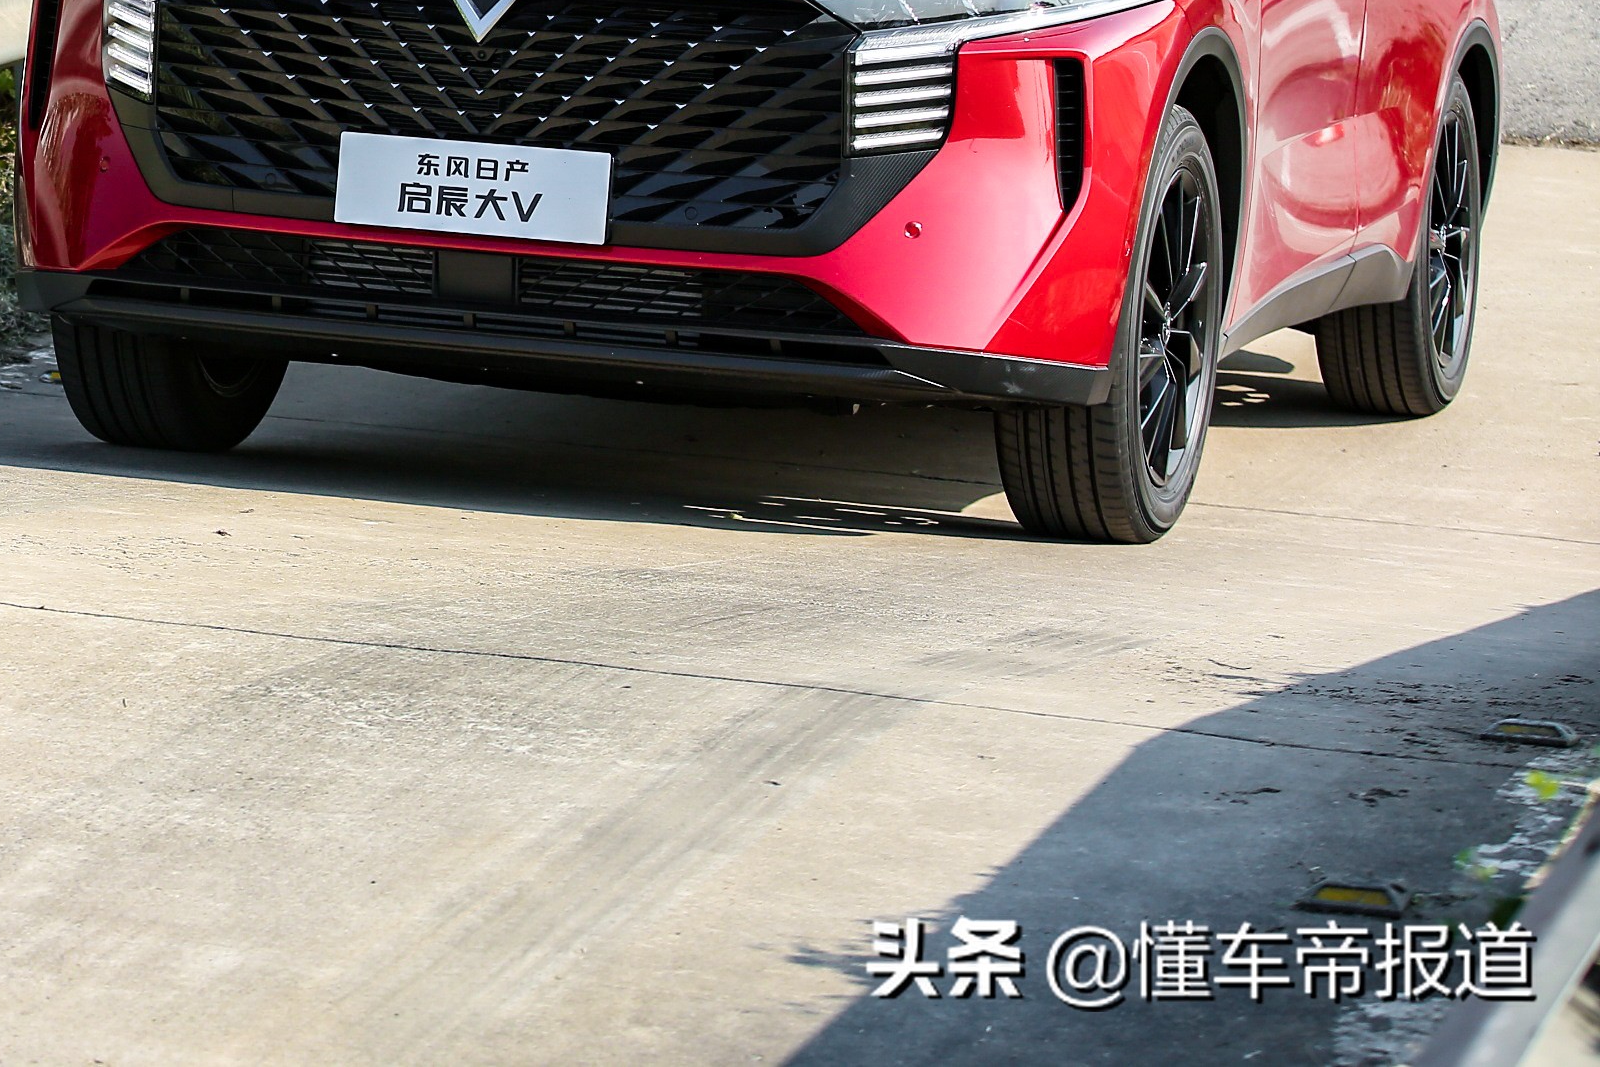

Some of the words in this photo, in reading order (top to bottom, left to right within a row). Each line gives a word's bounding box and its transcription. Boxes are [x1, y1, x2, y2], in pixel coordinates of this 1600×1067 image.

[416, 153, 529, 182] 东风日产
[397, 182, 543, 223] 启辰大V
